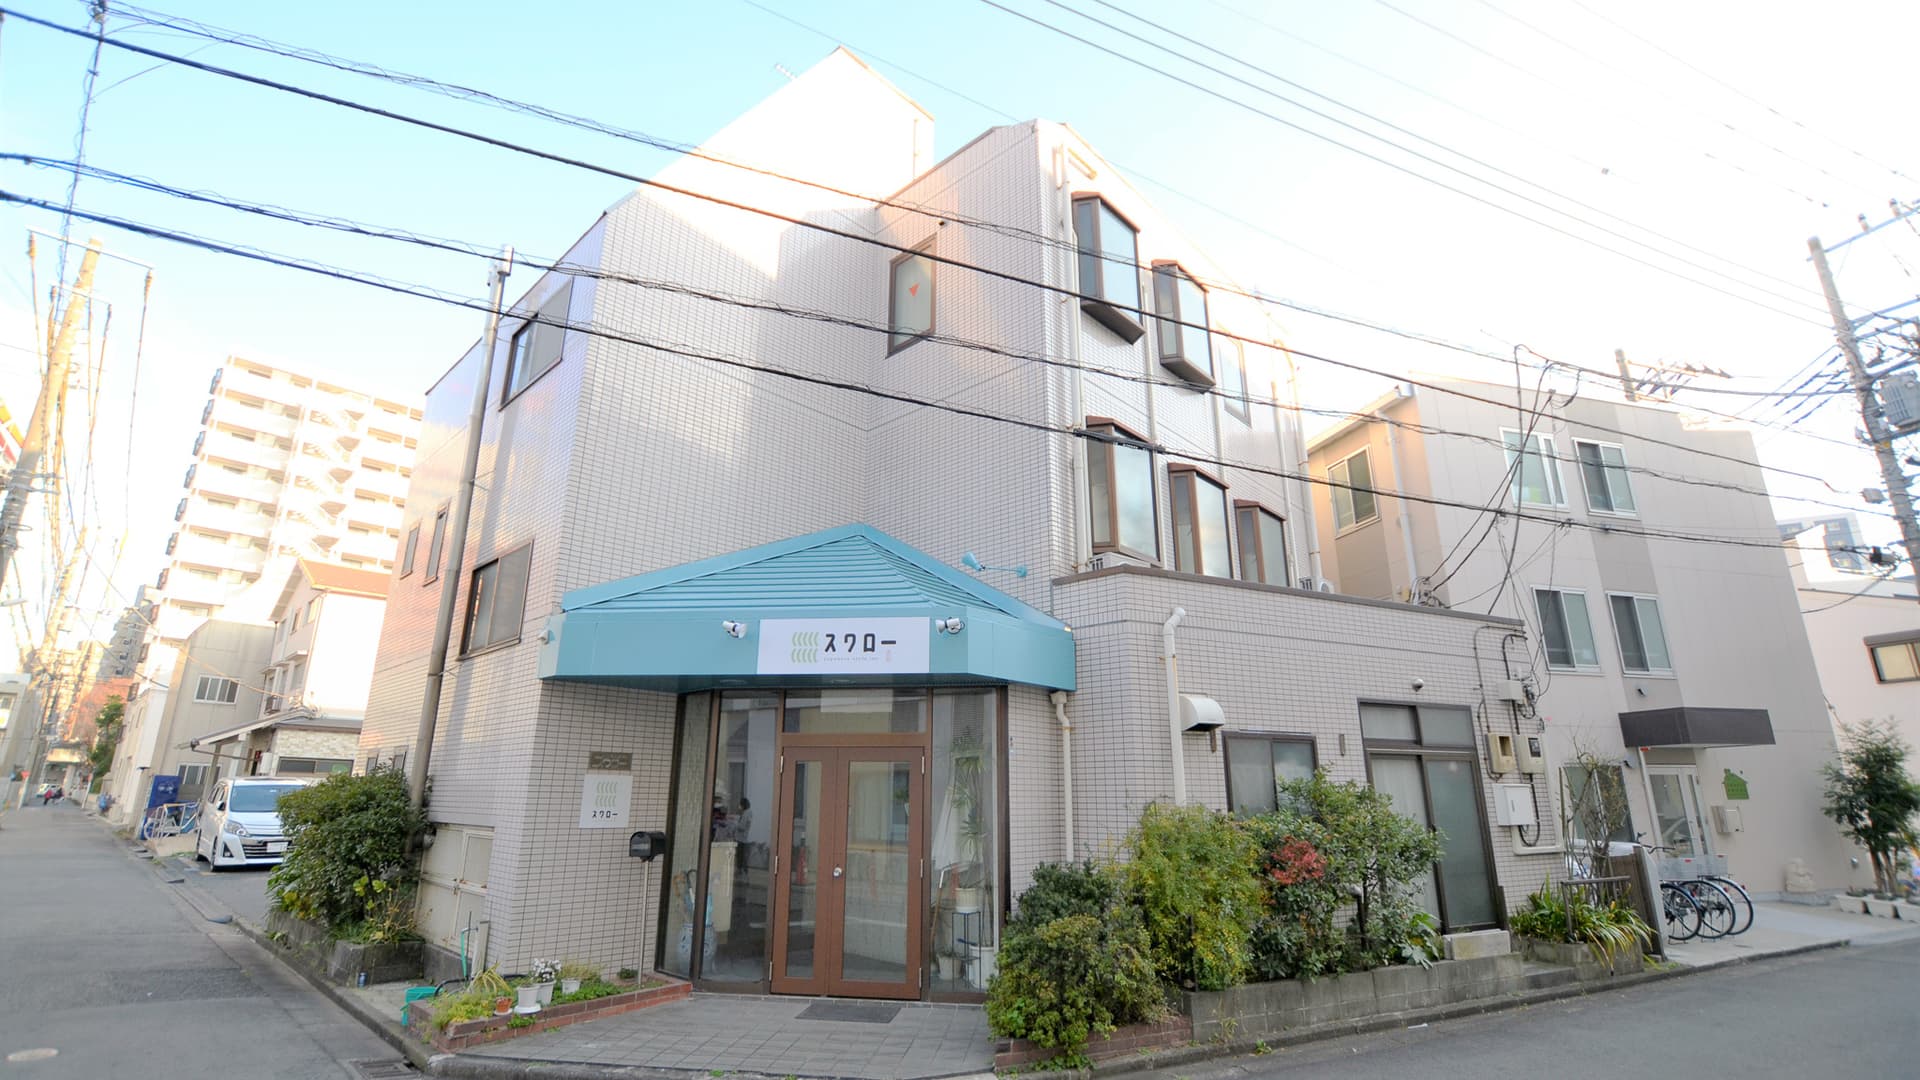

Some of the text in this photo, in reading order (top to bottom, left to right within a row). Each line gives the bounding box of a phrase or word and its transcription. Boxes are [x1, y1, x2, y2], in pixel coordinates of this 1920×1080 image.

[824, 633, 897, 653] スワロー
[592, 810, 618, 819] スワロー
